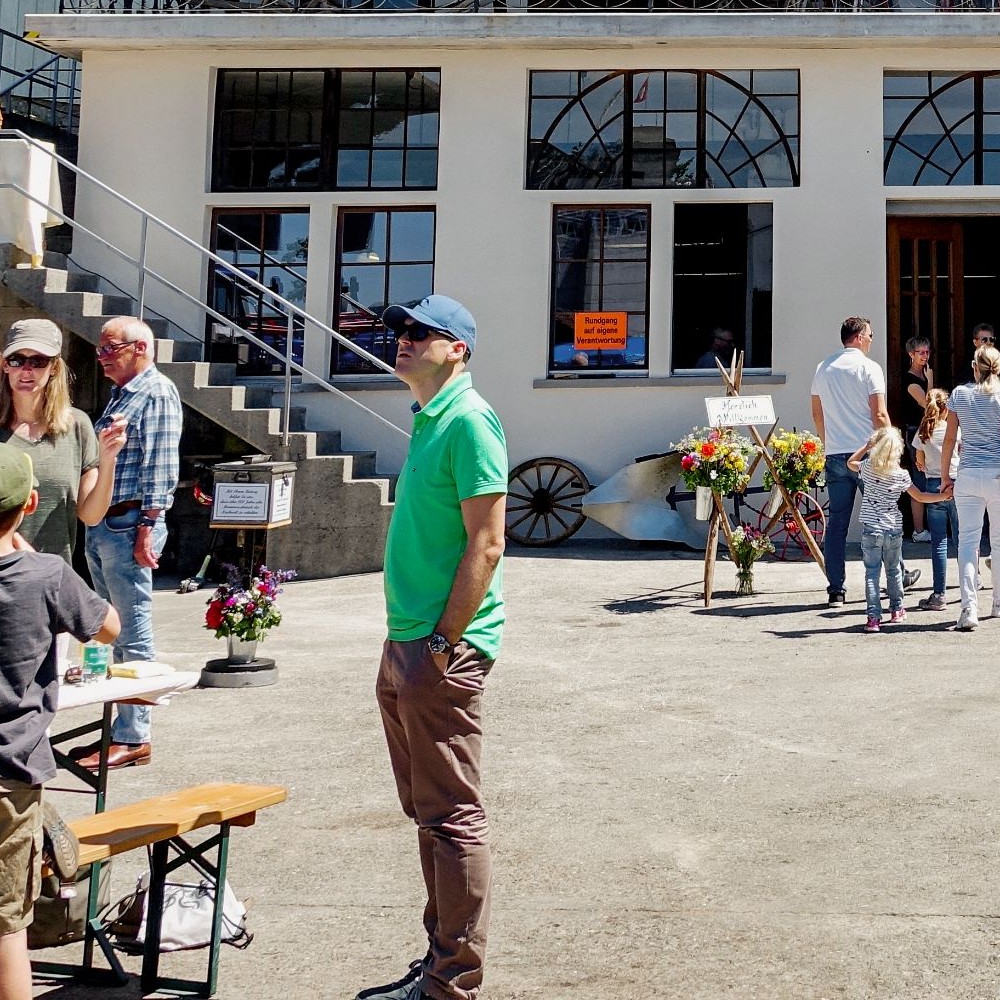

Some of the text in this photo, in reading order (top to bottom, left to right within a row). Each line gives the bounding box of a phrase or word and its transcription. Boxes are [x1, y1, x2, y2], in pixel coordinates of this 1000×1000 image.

[584, 316, 618, 325] Rundgang
[583, 326, 618, 335] auf eigene
[576, 336, 626, 345] Verantwortung
